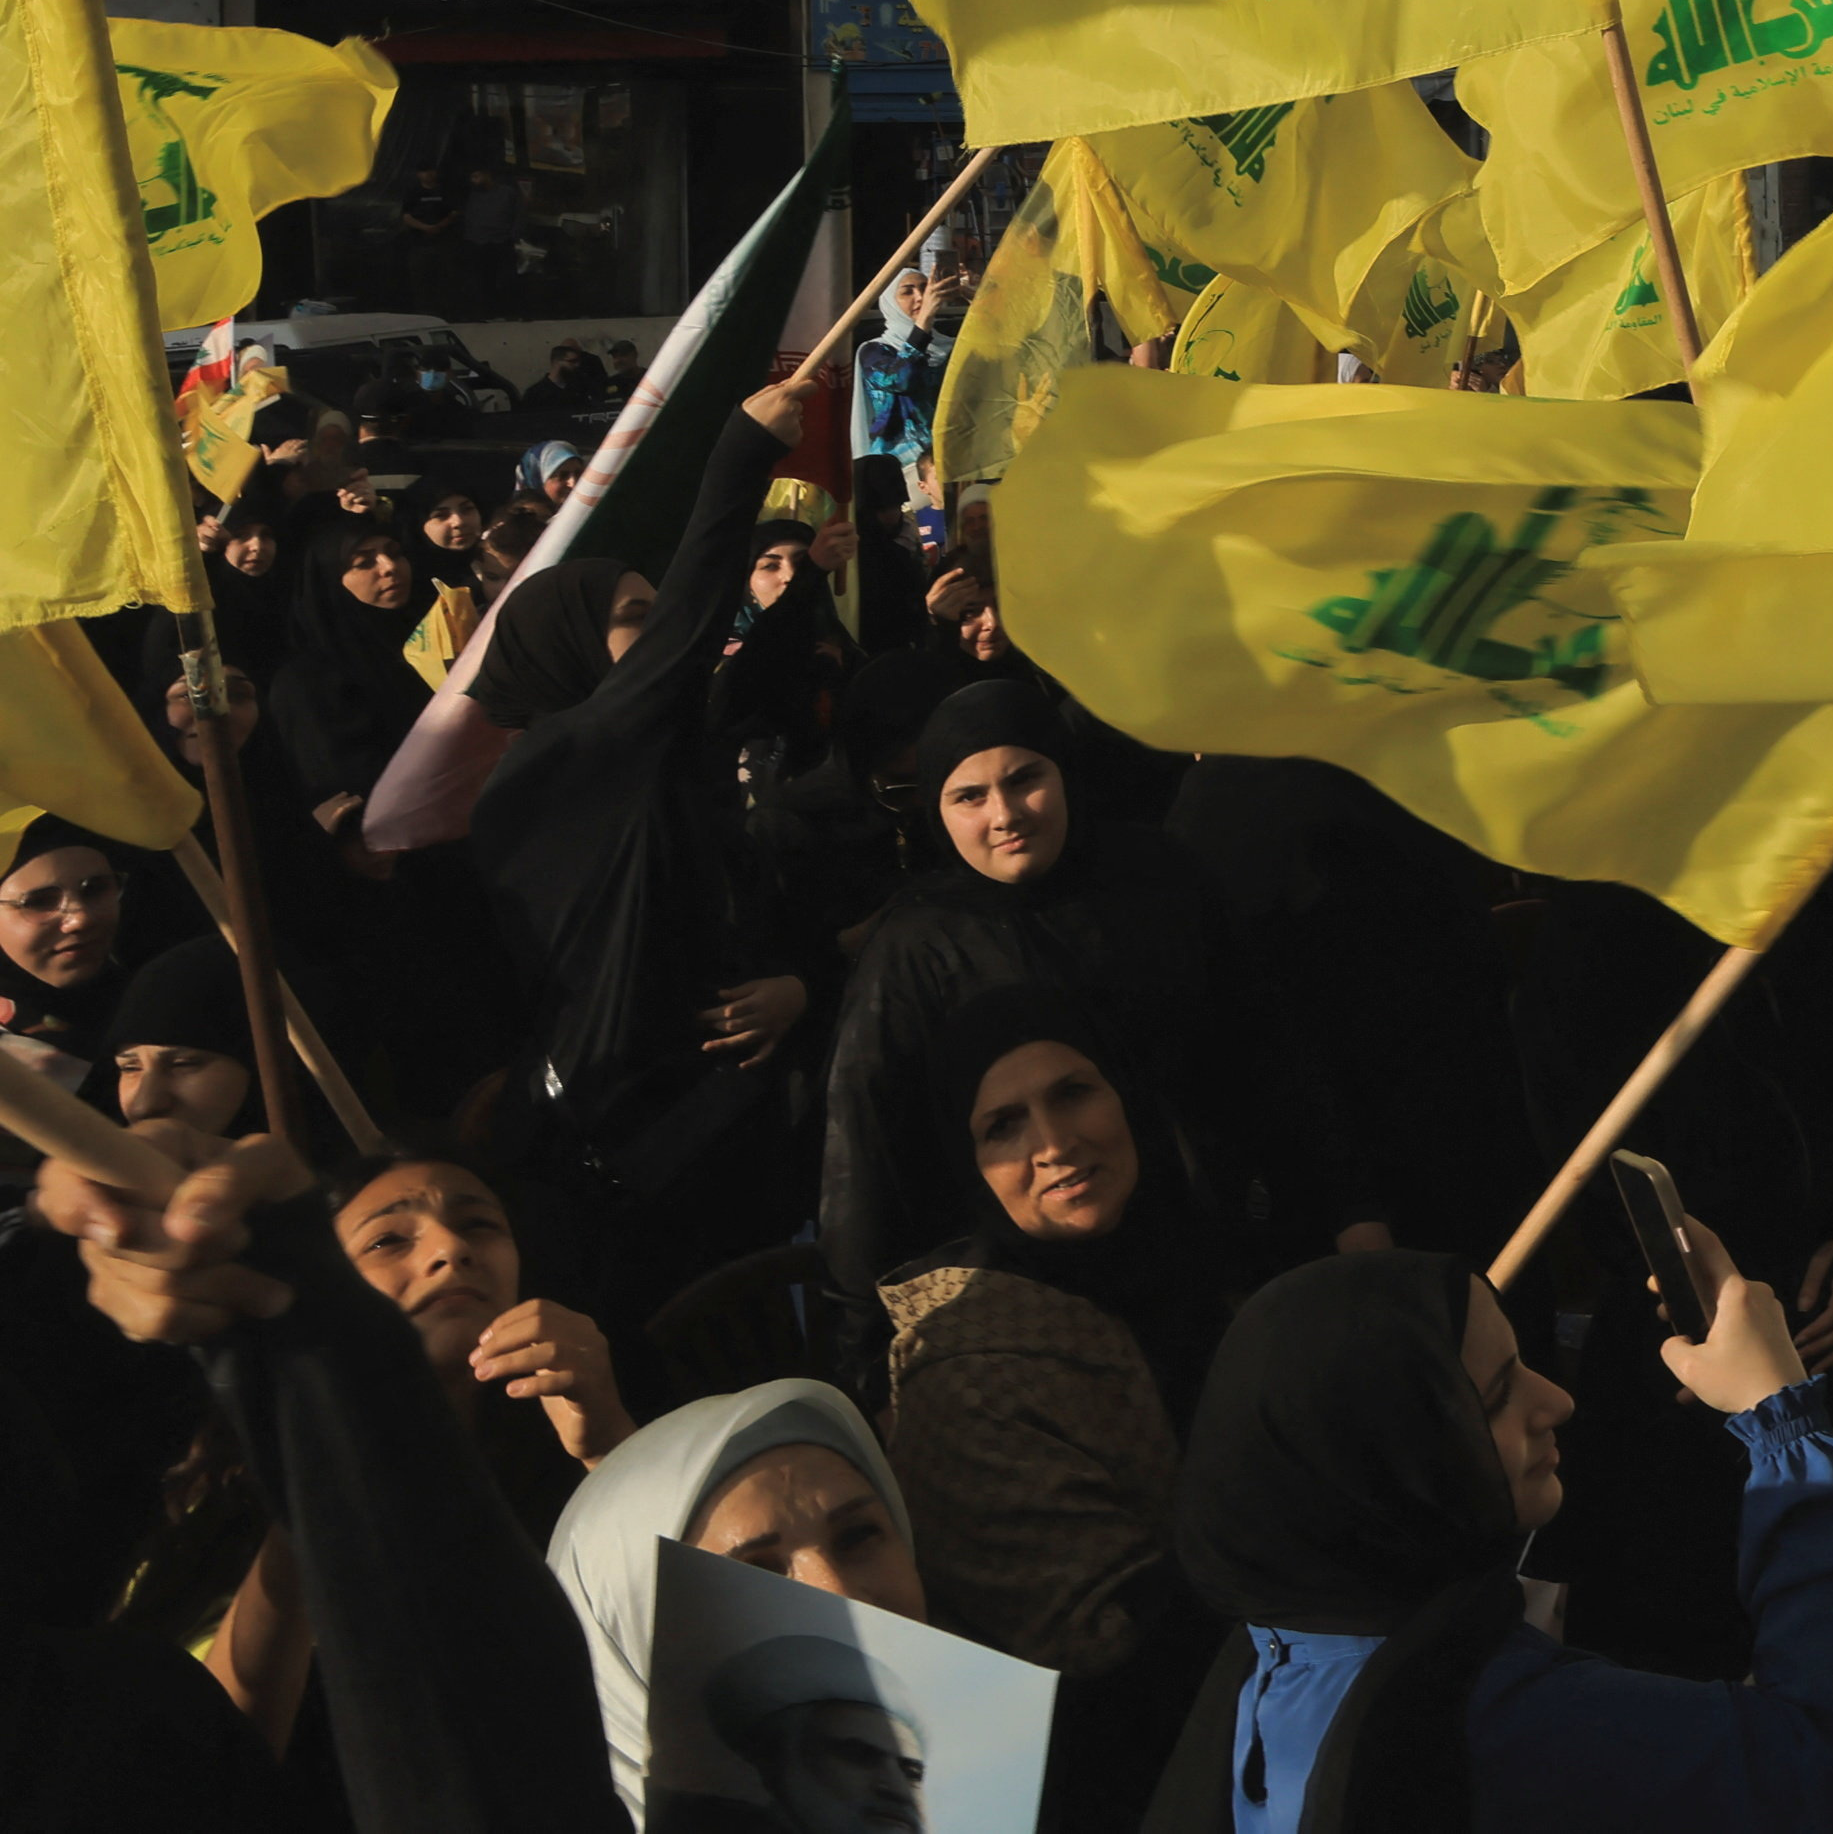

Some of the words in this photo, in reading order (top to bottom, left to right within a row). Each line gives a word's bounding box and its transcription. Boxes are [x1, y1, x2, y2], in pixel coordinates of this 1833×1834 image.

[1729, 66, 1808, 100] الإسلامية
[1652, 98, 1695, 126] لبنان
[1702, 87, 1727, 116] في
